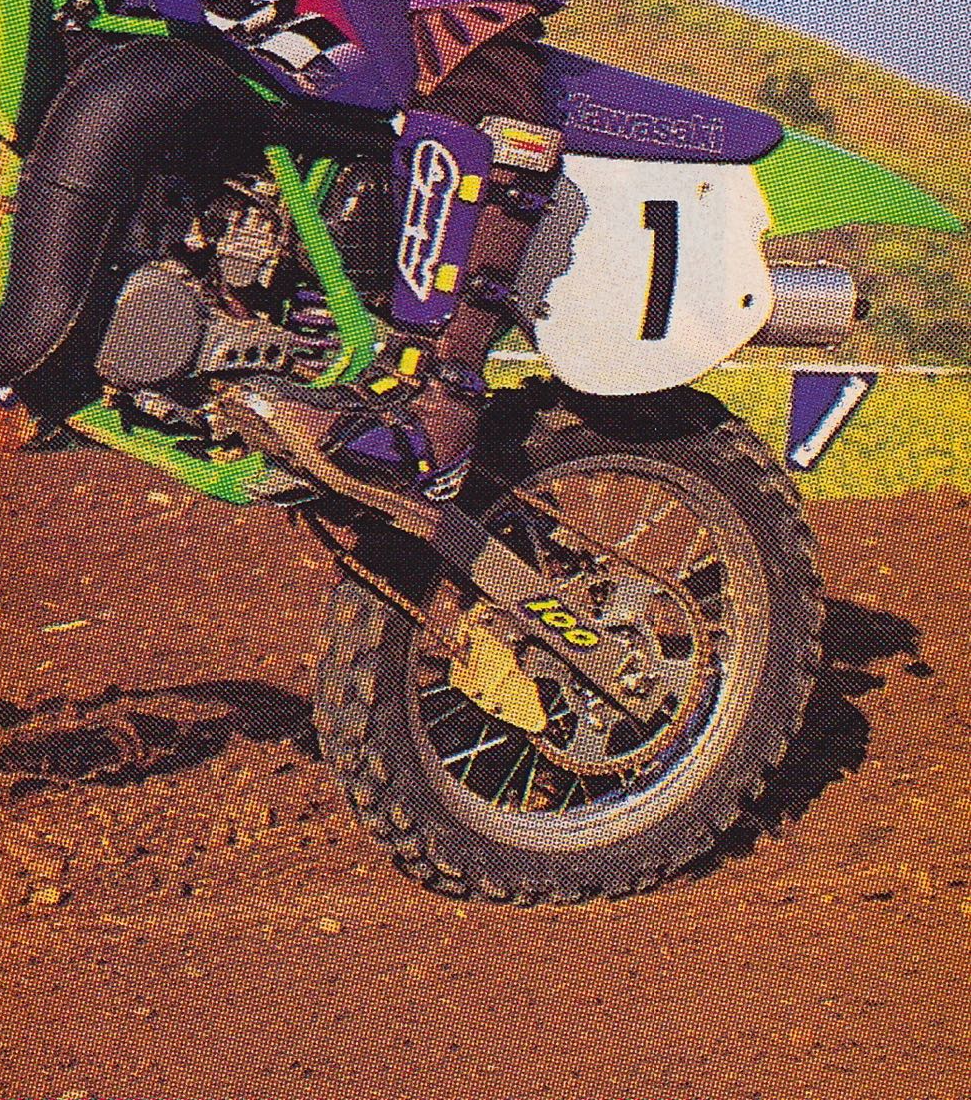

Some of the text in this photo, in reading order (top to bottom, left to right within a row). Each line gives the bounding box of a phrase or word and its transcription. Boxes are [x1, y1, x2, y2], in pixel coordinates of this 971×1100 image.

[565, 93, 726, 154] Kawasaki
[639, 200, 679, 340] 1
[522, 598, 600, 649] 100
